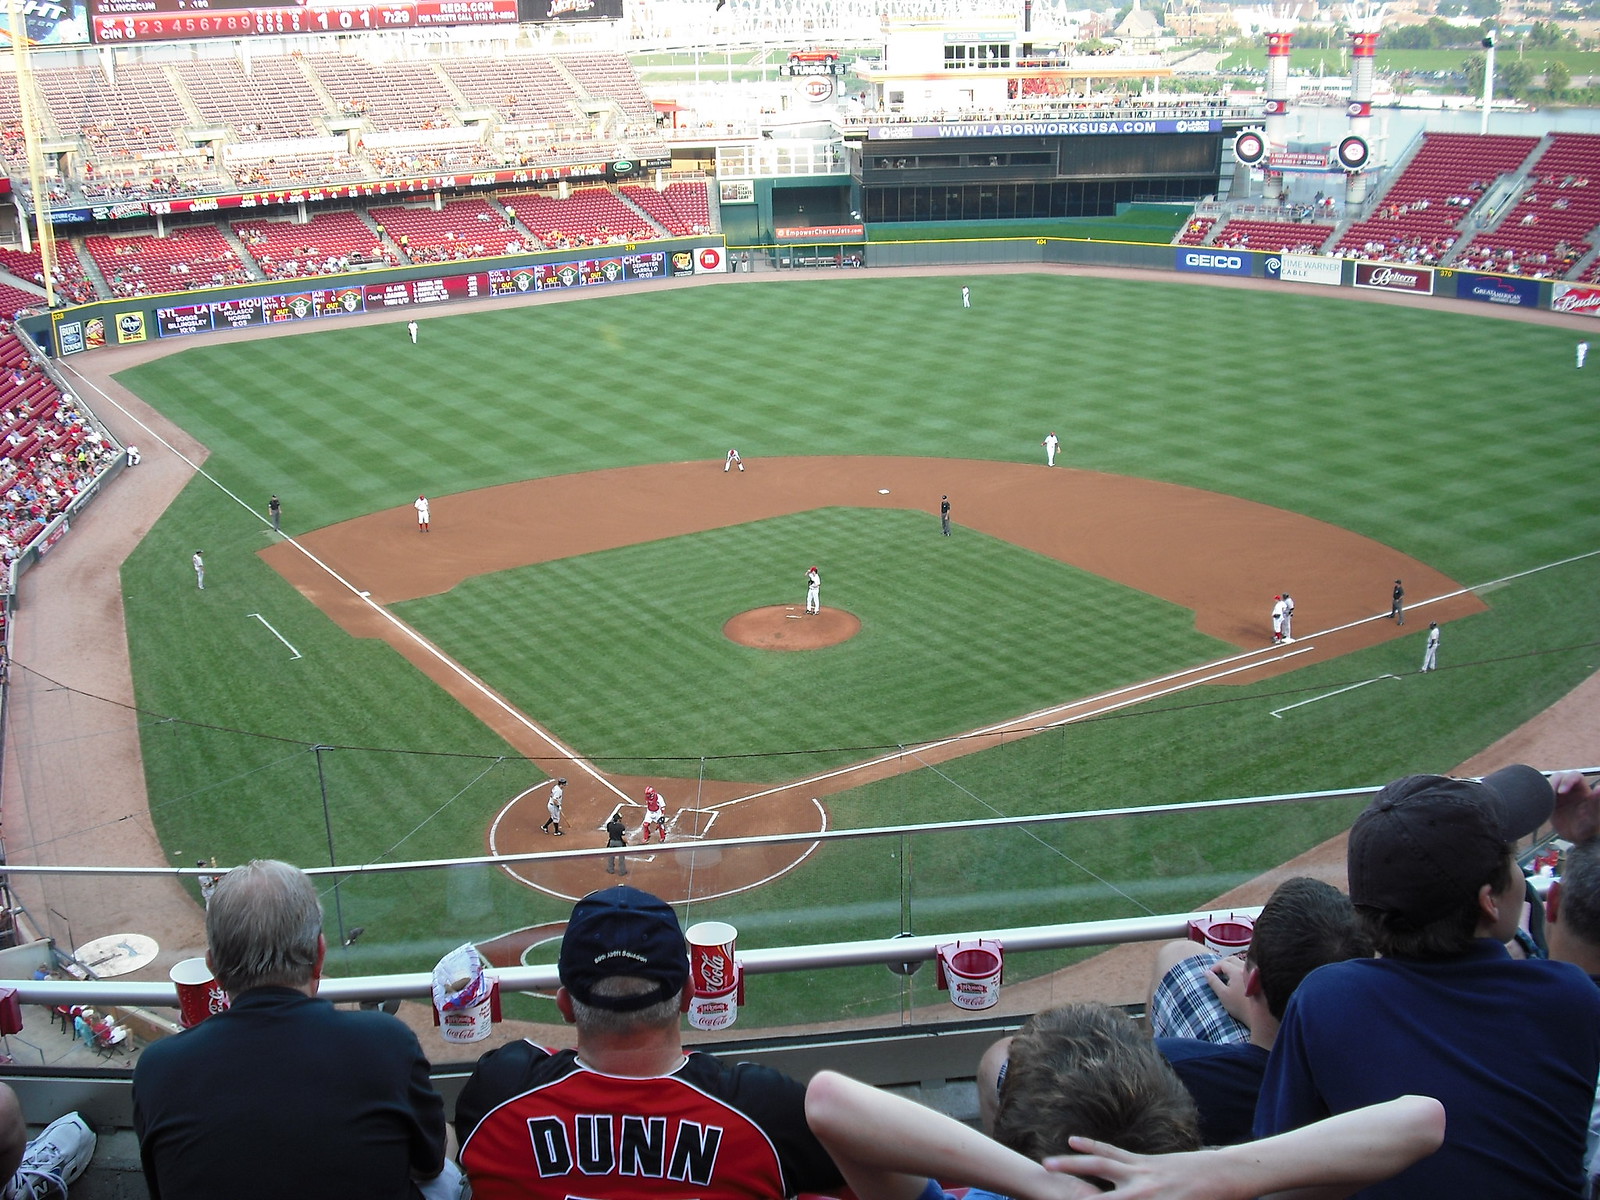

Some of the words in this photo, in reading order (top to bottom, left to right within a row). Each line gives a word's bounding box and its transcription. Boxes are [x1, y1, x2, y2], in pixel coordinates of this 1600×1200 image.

[111, 3, 156, 12] LINCECUM
[440, 3, 494, 13] REDS.COM
[124, 18, 135, 27] 0
[140, 22, 149, 33] 2
[154, 21, 163, 32] 3
[173, 20, 182, 31] 4
[187, 19, 195, 31] 5
[200, 18, 210, 30] 6
[213, 18, 222, 29] 7
[228, 17, 237, 29] 8
[241, 16, 251, 28] 9
[317, 13, 329, 29] 1
[340, 11, 352, 28] 0
[360, 11, 371, 27] 1
[101, 29, 122, 39] CIN
[126, 28, 136, 38] 0
[793, 65, 831, 75] TUNDRA
[938, 121, 1156, 137] WWW.LABORWORKSUSA.COM
[624, 256, 641, 265] CHC
[651, 253, 662, 261] SD
[1185, 254, 1241, 269] GEICO
[1283, 260, 1303, 268] TIME
[1304, 261, 1340, 271] WARNER
[490, 270, 503, 278] COL
[1282, 269, 1307, 277] CABLE
[1369, 268, 1418, 286] Belterra
[490, 276, 505, 284] WAS
[546, 277, 559, 285] OUT
[502, 282, 514, 290] OUT
[263, 296, 276, 304] ATL
[158, 309, 178, 319] STL
[194, 303, 208, 314] LA
[212, 302, 232, 313] FLA
[239, 299, 261, 309] HOU
[264, 302, 279, 311] NYM
[224, 308, 253, 316] NOLASCO
[276, 308, 289, 316] OUT
[62, 325, 79, 336] BUILT
[64, 344, 81, 354] TOUGH
[527, 1114, 723, 1186] DUNN
